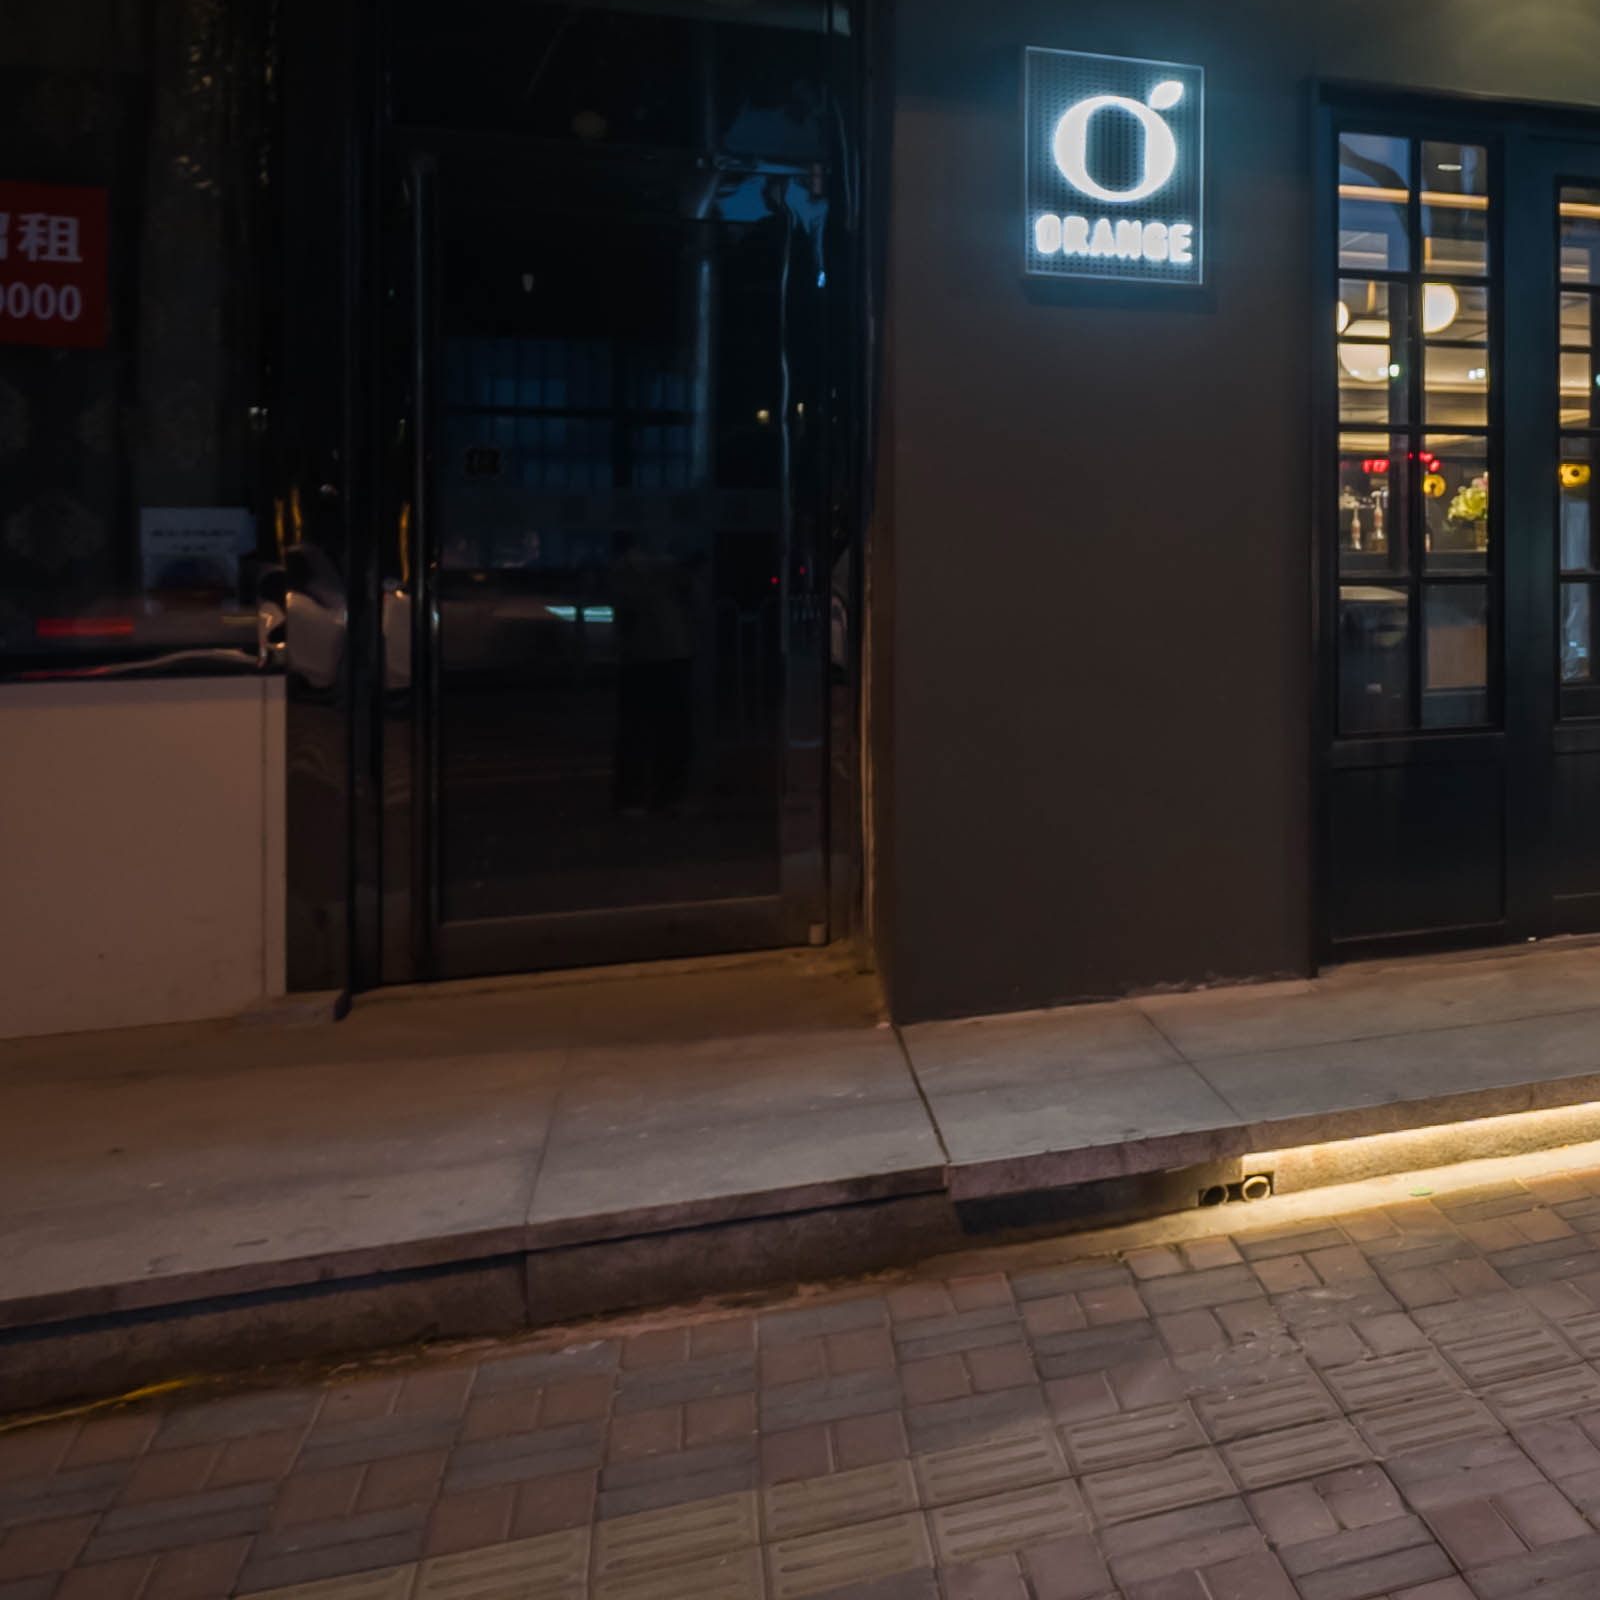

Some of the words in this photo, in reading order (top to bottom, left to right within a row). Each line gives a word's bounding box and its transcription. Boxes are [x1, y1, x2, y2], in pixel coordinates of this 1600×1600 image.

[0, 211, 84, 264] 租
[1034, 213, 1193, 263] ORANGE
[0, 279, 83, 323] 000
